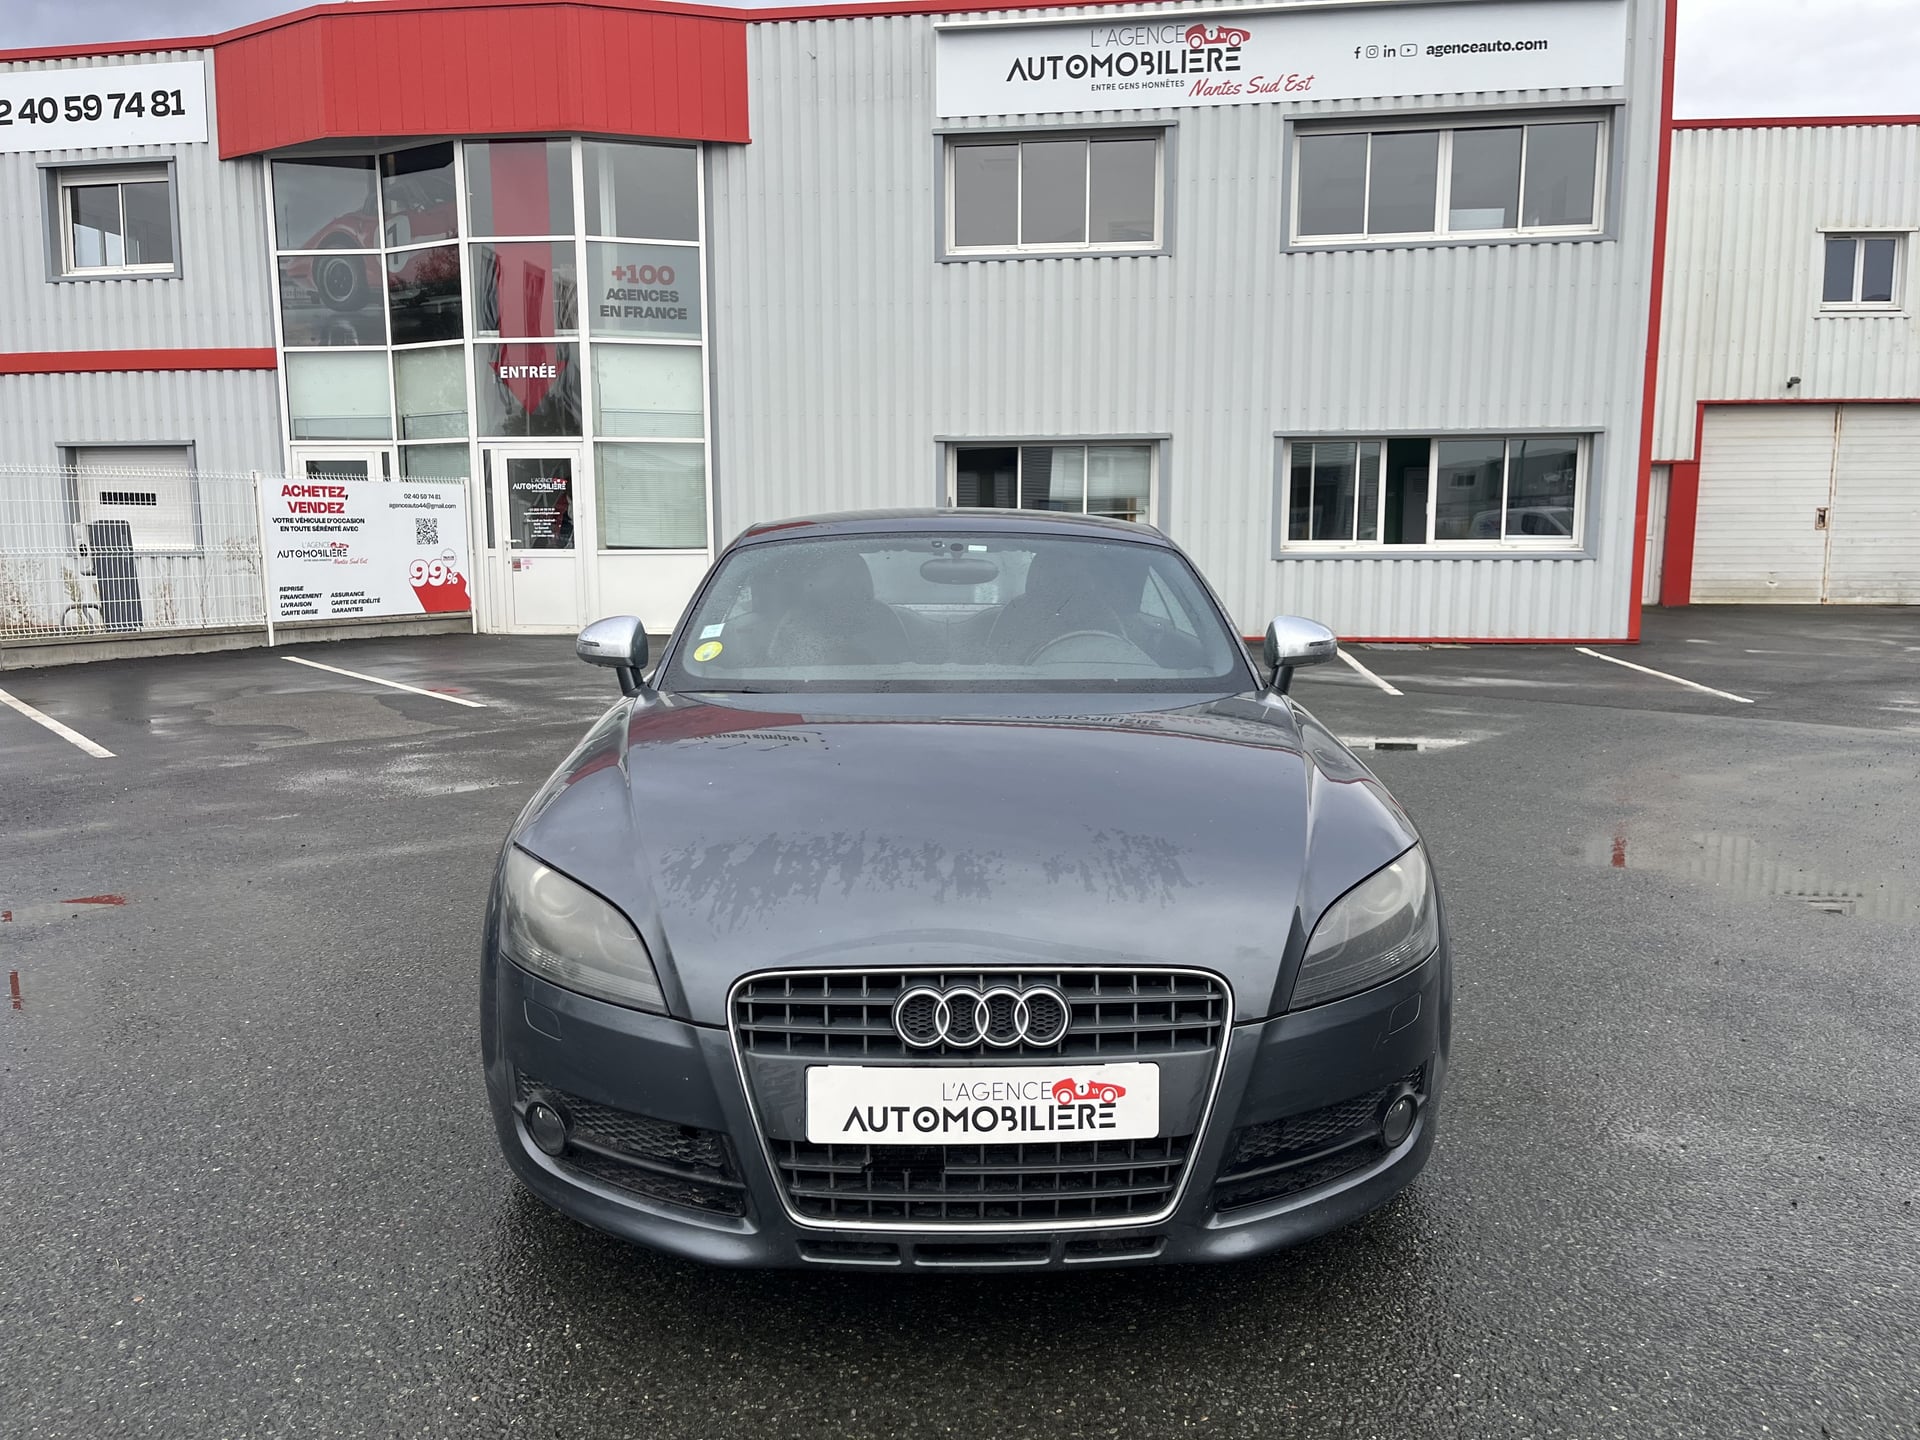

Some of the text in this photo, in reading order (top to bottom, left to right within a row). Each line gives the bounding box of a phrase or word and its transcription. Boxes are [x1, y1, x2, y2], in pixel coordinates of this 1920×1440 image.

[1091, 24, 1186, 48] L'AGENCE
[1426, 39, 1548, 58] agenceauto.com
[1091, 79, 1185, 92] ENTRE GENS HONNÊTES
[1188, 73, 1316, 97] Nantes Sud Est
[18, 97, 59, 124] 40
[64, 94, 103, 122] 59
[107, 91, 146, 119] 74
[150, 89, 186, 117] 81
[611, 264, 675, 285] +100
[606, 288, 679, 303] AGENCES
[600, 305, 687, 320] EN FRANCE
[500, 363, 557, 378] ENTRÉE
[281, 485, 349, 500] ACHETEZ,
[287, 502, 345, 513] VENDEZ
[942, 1081, 1052, 1102] L'AGENCE
